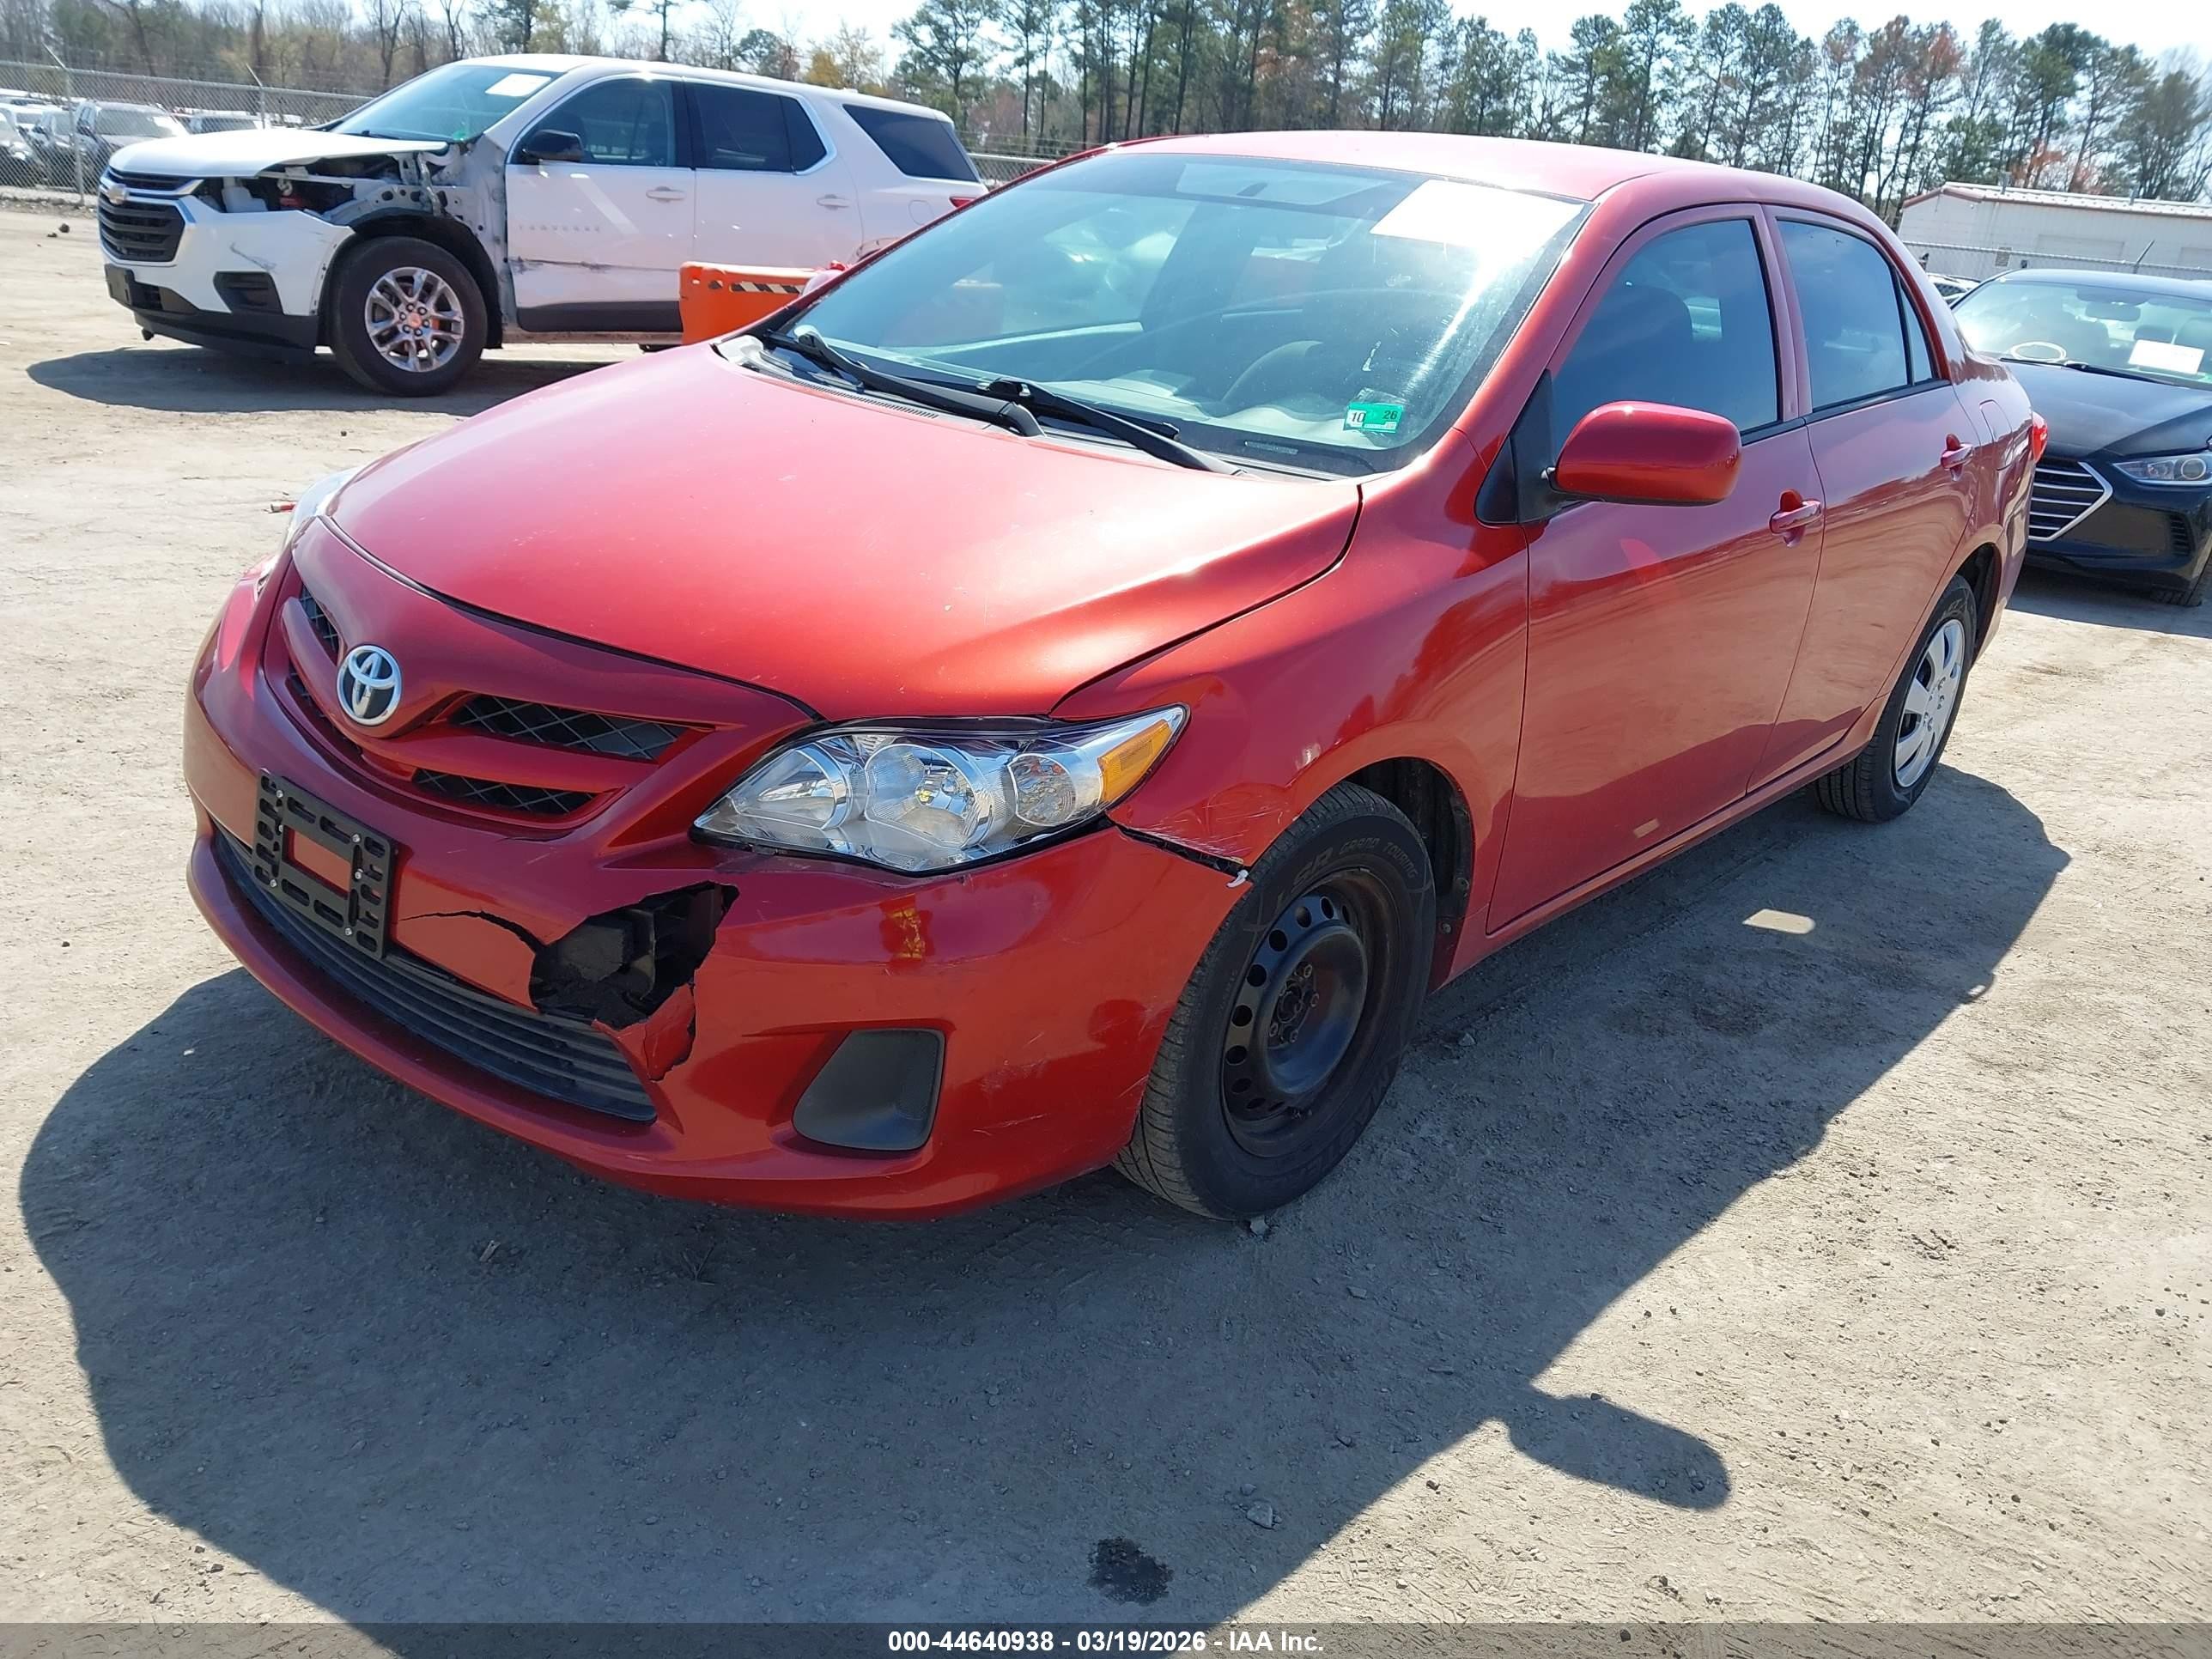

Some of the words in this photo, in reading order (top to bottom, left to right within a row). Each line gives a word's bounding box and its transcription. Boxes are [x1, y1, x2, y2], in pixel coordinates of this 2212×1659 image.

[1352, 412, 1367, 423] 10
[1382, 410, 1399, 421] 26
[1381, 840, 1420, 879] TOURING
